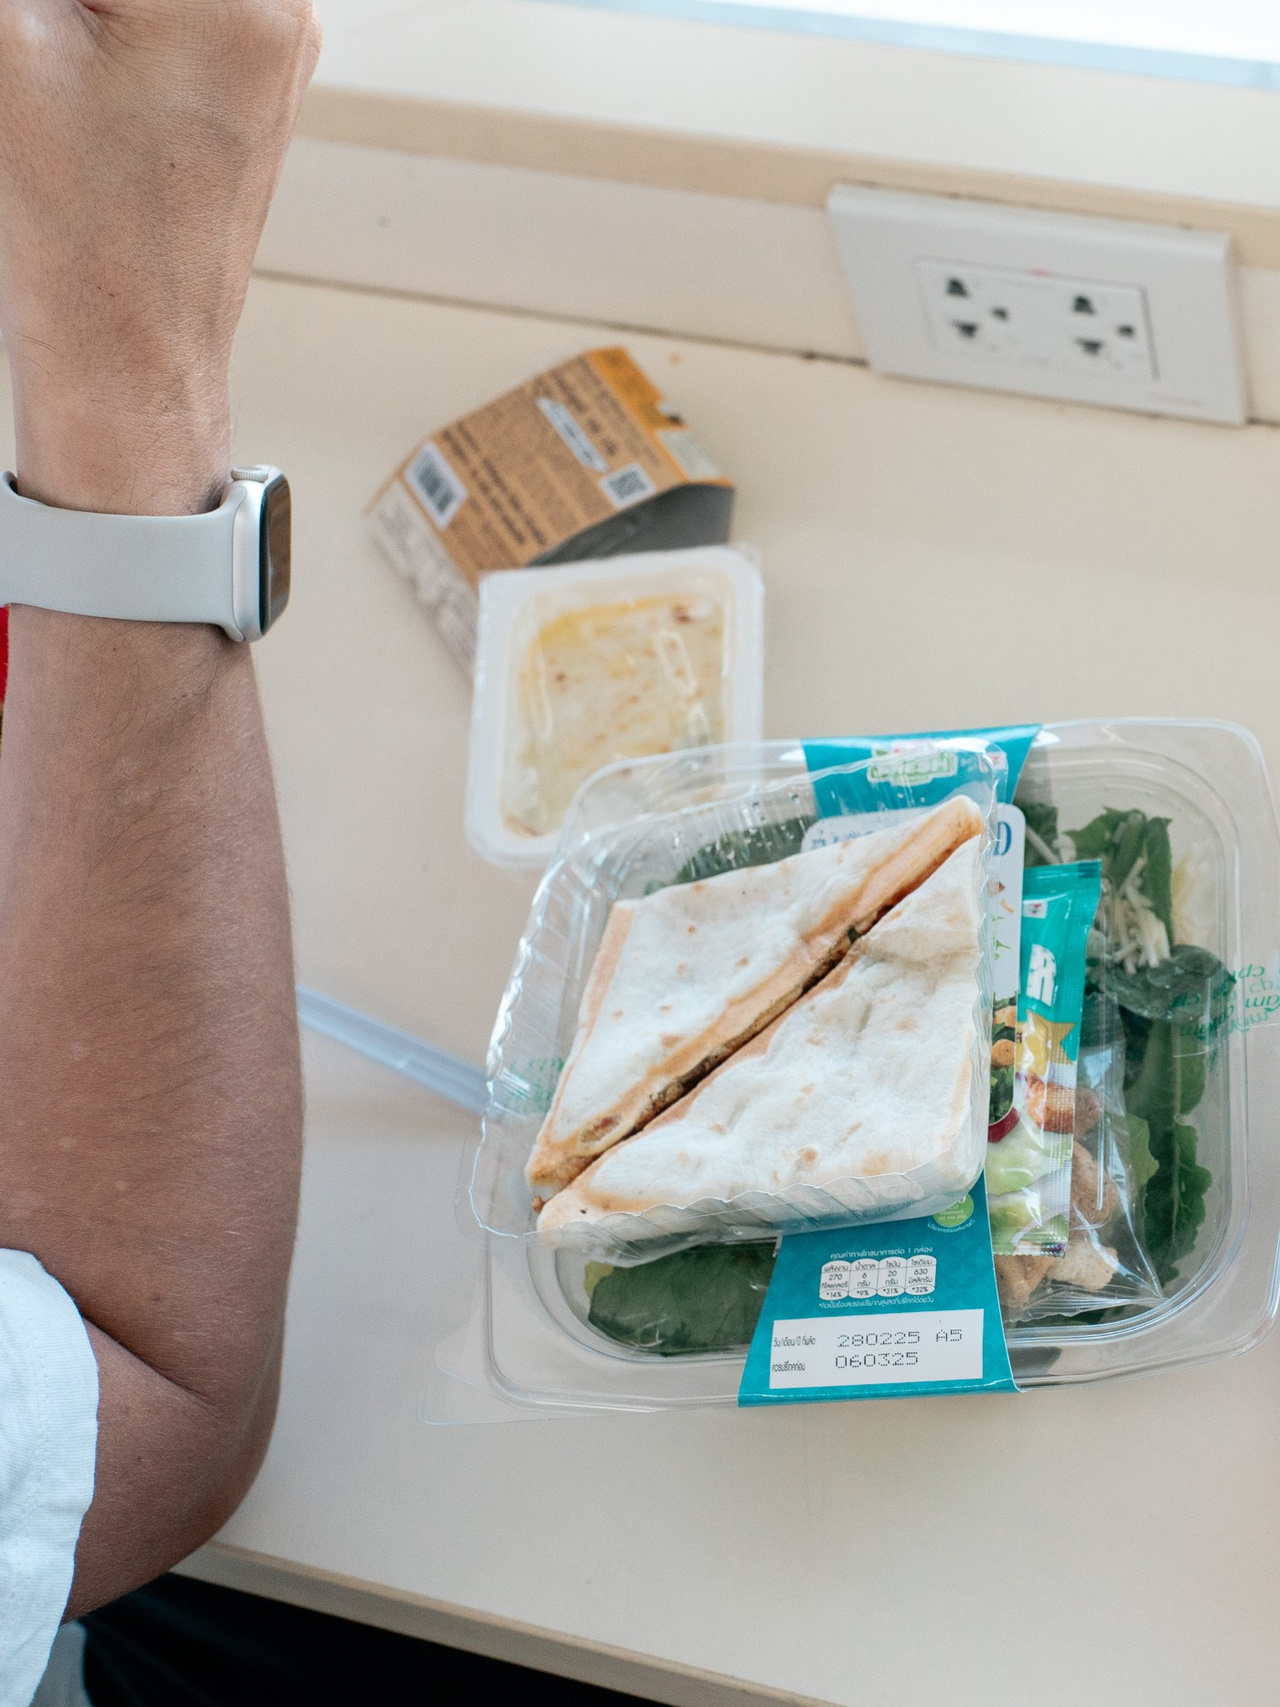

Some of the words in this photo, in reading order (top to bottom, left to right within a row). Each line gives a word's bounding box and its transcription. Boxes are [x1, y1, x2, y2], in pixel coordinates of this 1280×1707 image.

[914, 1268, 928, 1276] 630
[837, 1331, 920, 1347] 280225
[936, 1329, 962, 1342] A5
[835, 1352, 918, 1368] 060325
